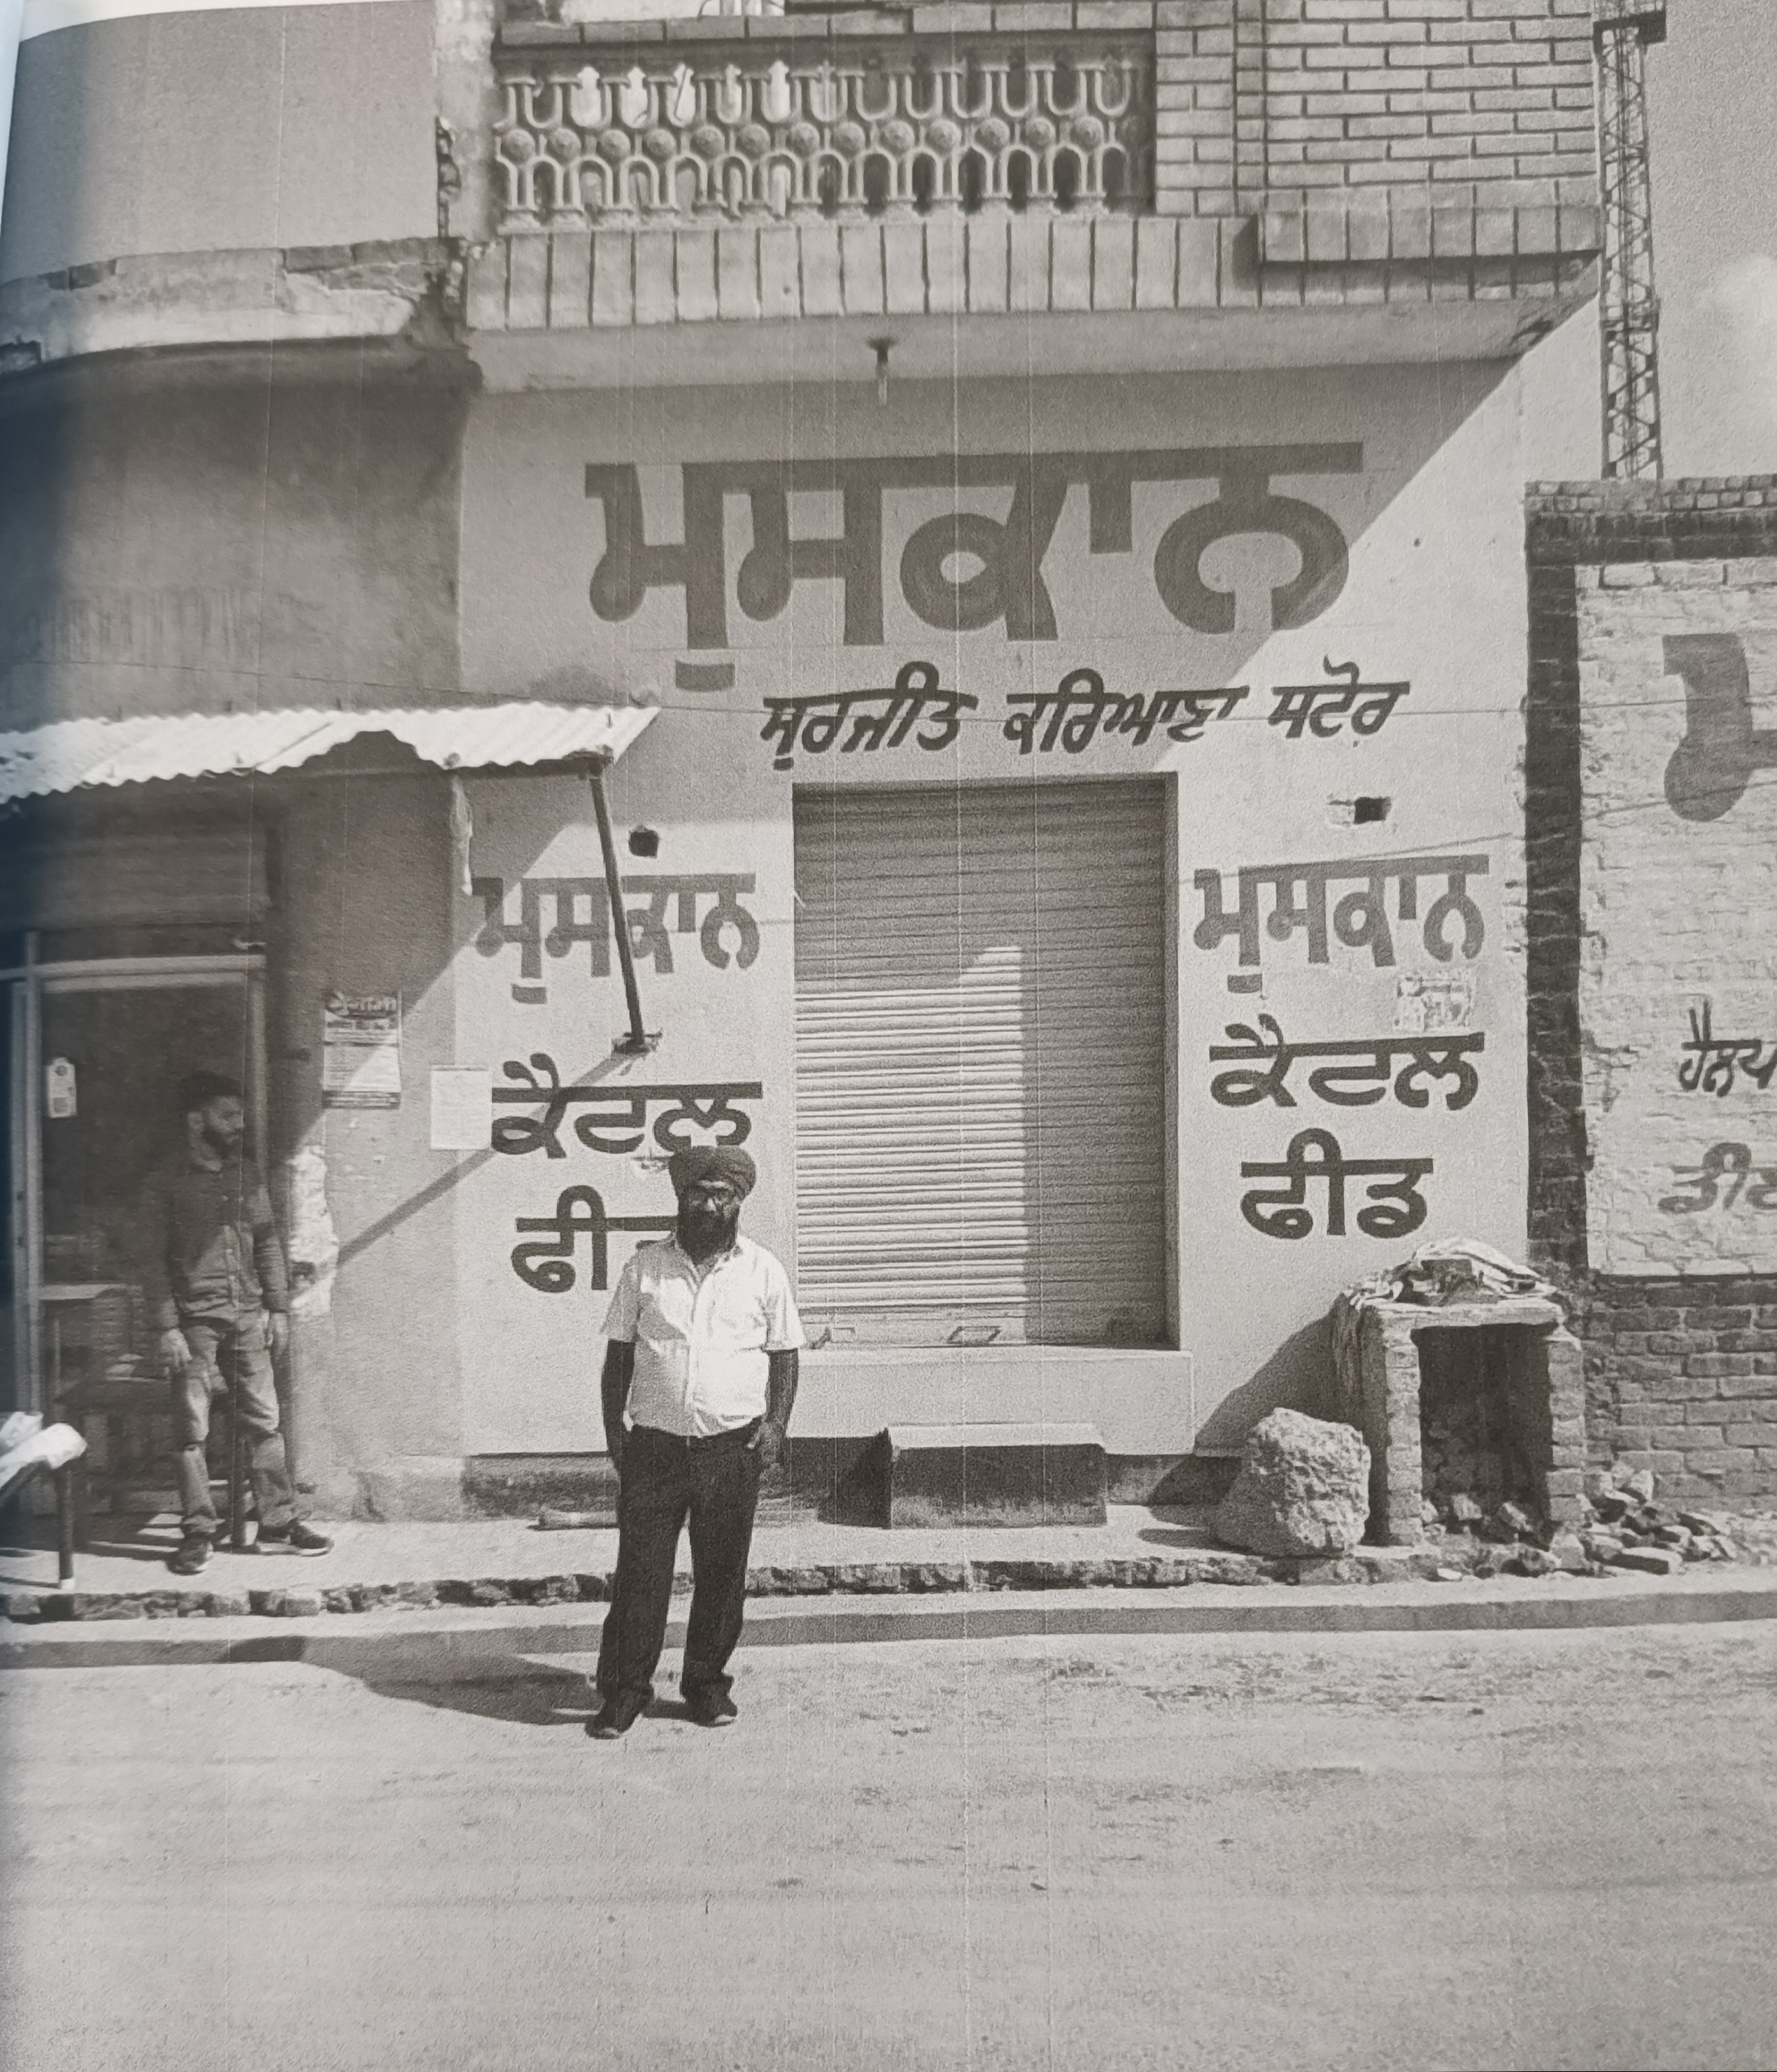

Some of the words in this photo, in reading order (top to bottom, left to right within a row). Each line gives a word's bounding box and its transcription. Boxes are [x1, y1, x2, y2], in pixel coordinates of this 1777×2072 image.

[585, 442, 1363, 692] ਮੁਸਕਾਨ
[760, 661, 979, 770] ਸੁਰਜੀਤ
[1267, 654, 1410, 739] ਸਟੋਰ
[472, 873, 761, 1005] ਮੁਸਕਾਨ
[1194, 854, 1489, 994] ਮੁਸਕਾਨ
[491, 1053, 763, 1159] ਕੈਟਲ
[1209, 1013, 1485, 1111] ਕੈਟਲ
[511, 1185, 678, 1293] ਫੀ
[1240, 1127, 1433, 1240] ਫੀਡ
